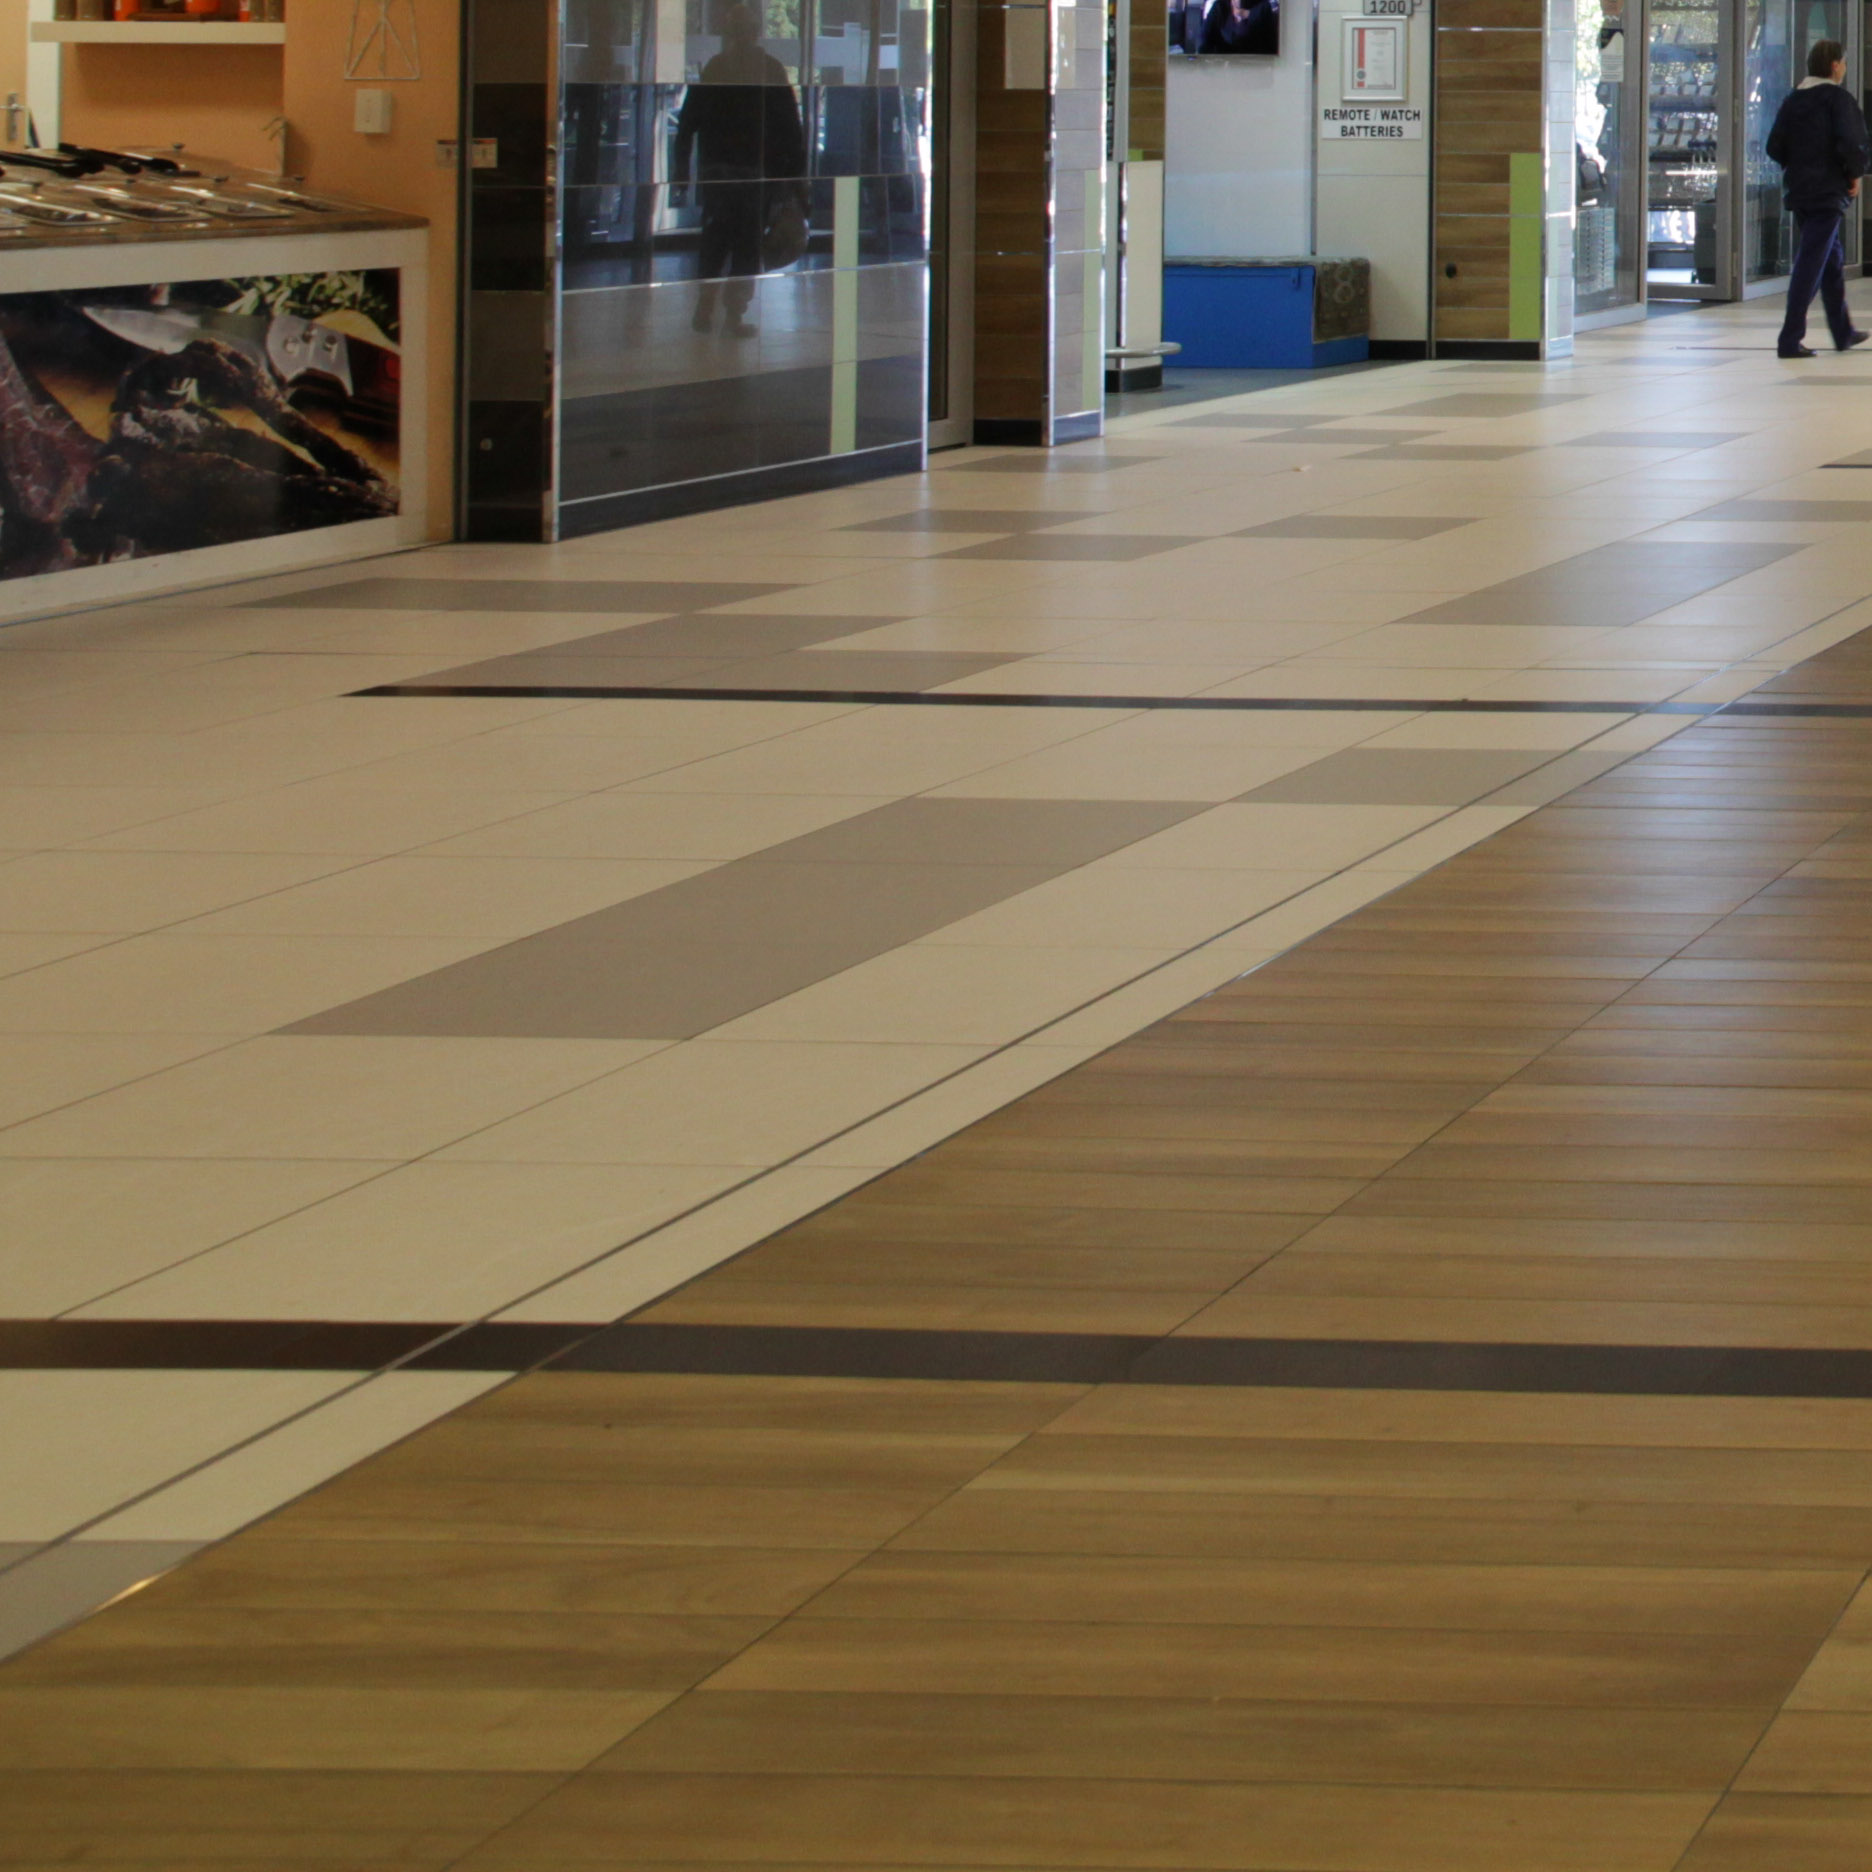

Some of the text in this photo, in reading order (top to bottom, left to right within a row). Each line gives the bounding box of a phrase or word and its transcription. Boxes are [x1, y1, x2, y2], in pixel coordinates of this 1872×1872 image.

[1370, 0, 1406, 14] 1200
[1323, 109, 1371, 121] REMOTE
[1380, 109, 1421, 121] WATCH
[1341, 126, 1404, 137] BATTERIES
